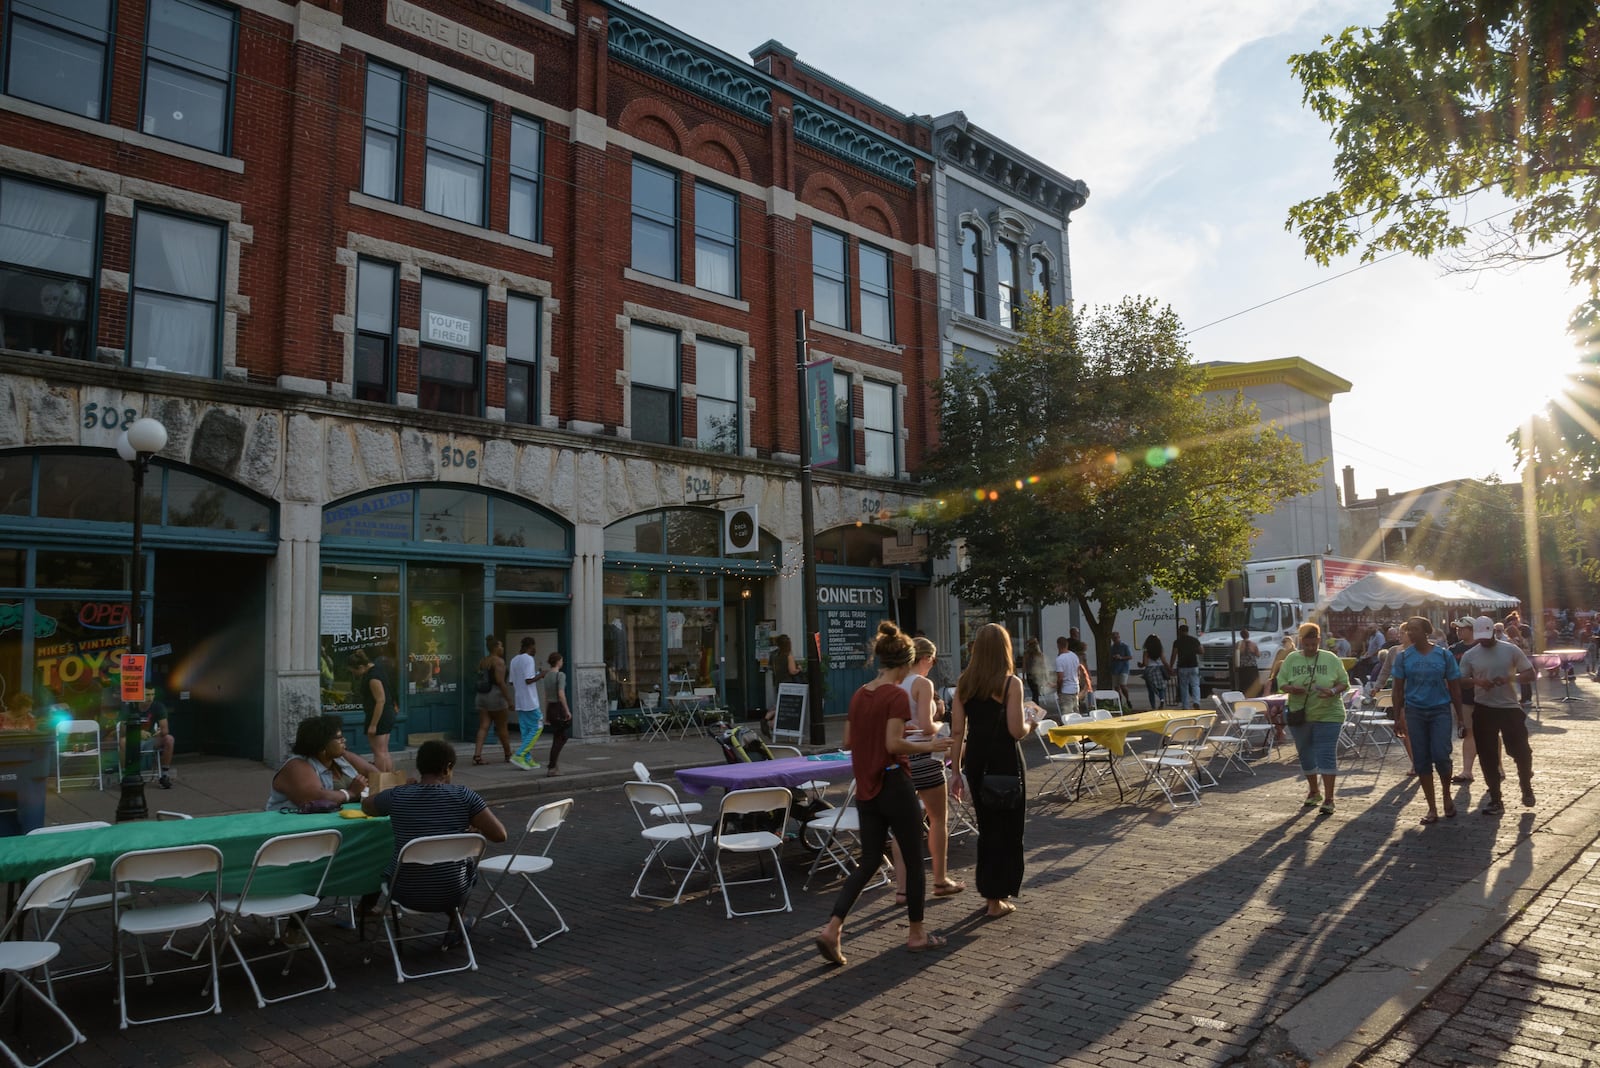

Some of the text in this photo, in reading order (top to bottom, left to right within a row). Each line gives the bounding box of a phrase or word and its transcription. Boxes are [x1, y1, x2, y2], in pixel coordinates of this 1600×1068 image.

[389, 0, 449, 43] WARE
[430, 315, 470, 332] YOU'RE
[432, 329, 468, 345] FIRED!
[84, 402, 136, 431] 508
[441, 445, 477, 469] 506
[686, 475, 712, 495] 504
[325, 491, 411, 524] DERAILED
[862, 497, 880, 514] 502
[816, 586, 883, 604] ONNETT'S
[79, 635, 129, 651] VINTAGE
[333, 625, 388, 645] DERAILED
[37, 648, 129, 686] TOYS
[1292, 664, 1328, 677] DECAUR
